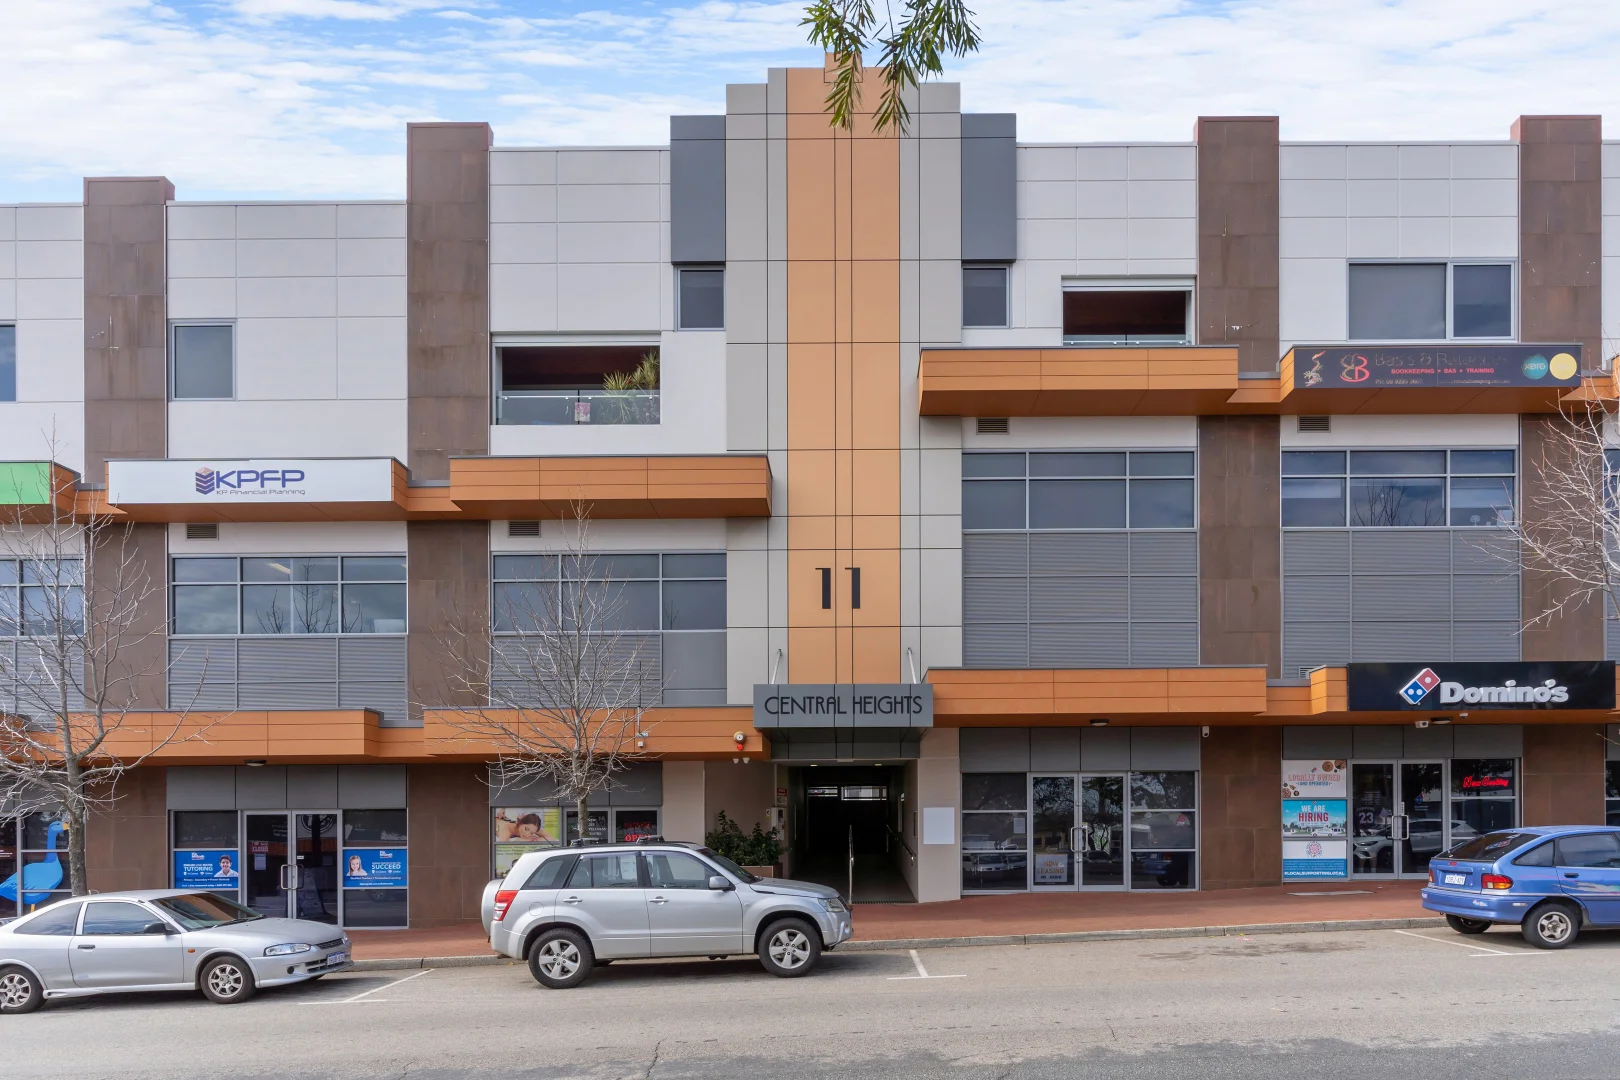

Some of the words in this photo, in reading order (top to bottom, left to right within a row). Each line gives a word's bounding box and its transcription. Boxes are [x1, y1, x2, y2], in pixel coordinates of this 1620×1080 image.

[1524, 363, 1546, 371] xero
[216, 470, 305, 488] KPFP
[1439, 679, 1569, 704] Domino's
[764, 696, 847, 715] CENTRAL
[852, 695, 923, 714] HEIGHTS
[1463, 776, 1481, 788] Now
[1481, 776, 1509, 788] Cooking
[1298, 812, 1329, 822] HIRING
[1358, 812, 1374, 824] 23
